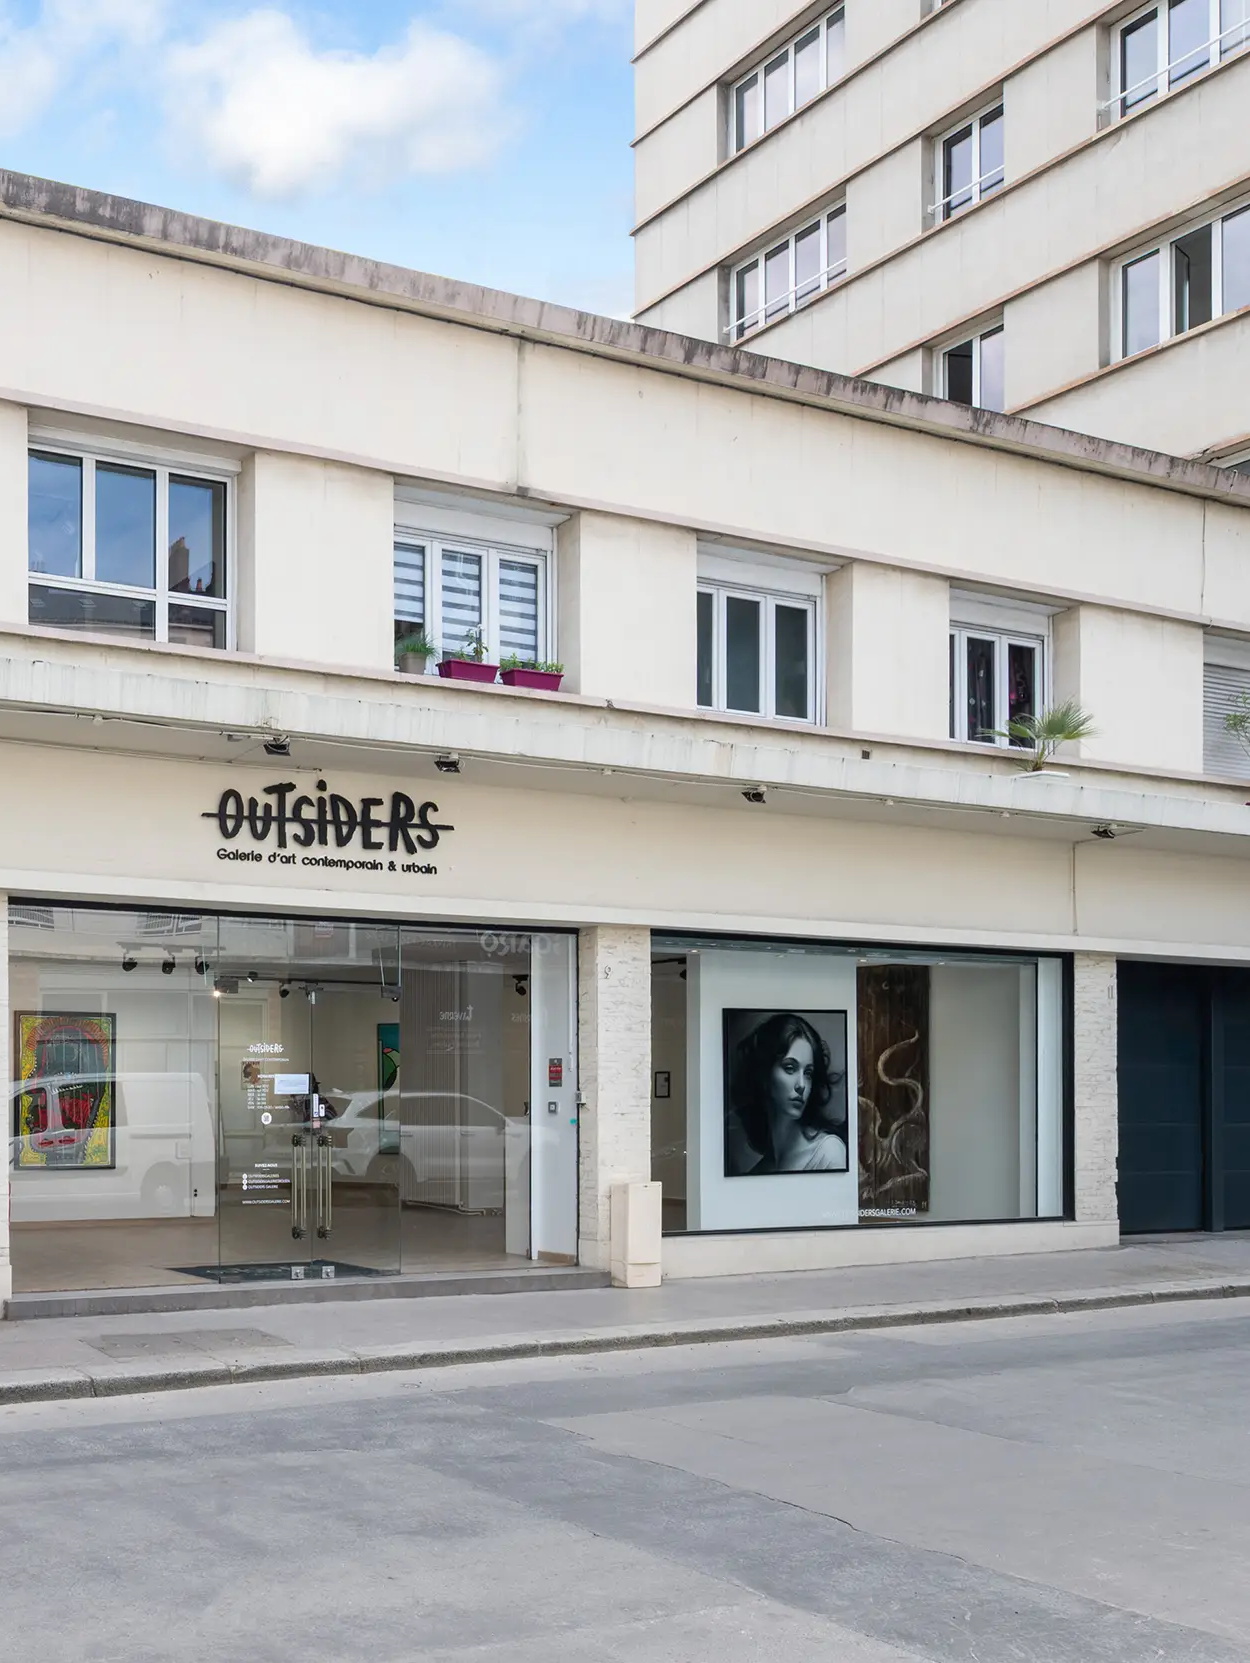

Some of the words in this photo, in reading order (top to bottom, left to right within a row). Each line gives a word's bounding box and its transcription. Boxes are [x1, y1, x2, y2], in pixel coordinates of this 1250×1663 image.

[217, 848, 262, 862] Galerie
[268, 852, 297, 864] d'art
[302, 856, 383, 871] contemporain
[388, 860, 397, 871] &
[402, 863, 437, 874] urbain
